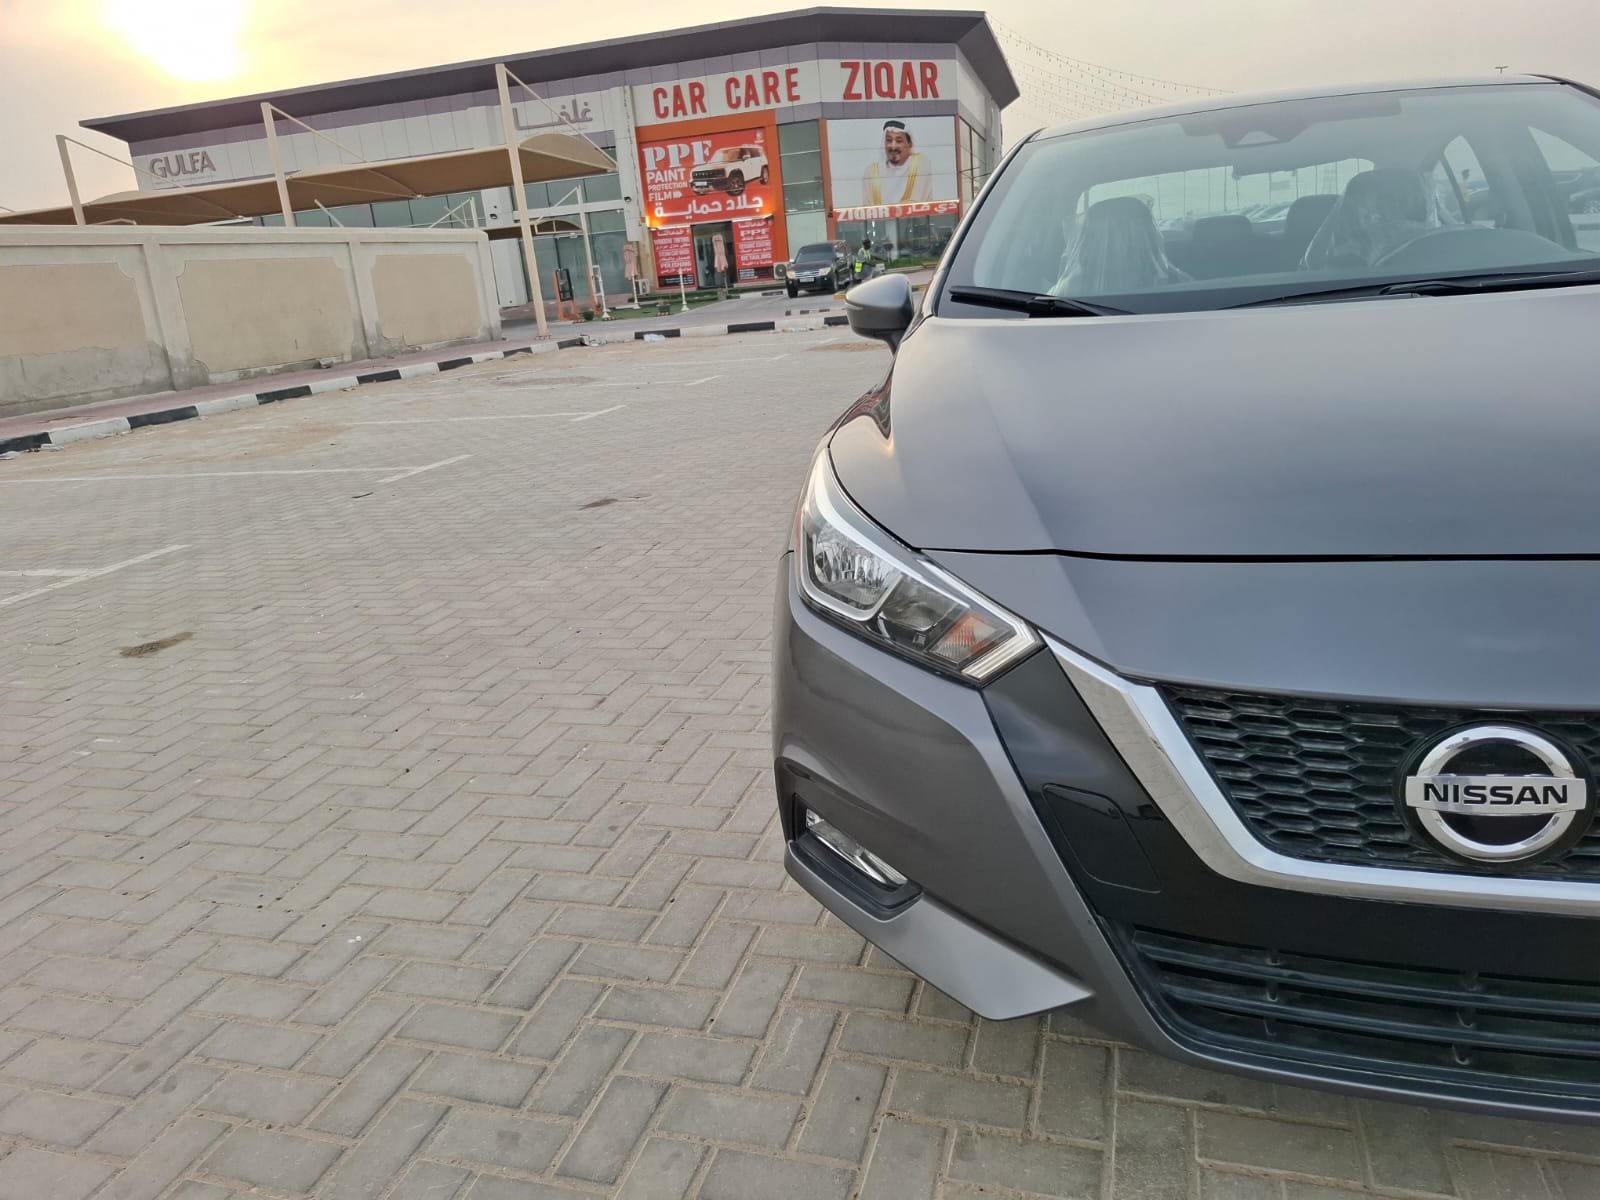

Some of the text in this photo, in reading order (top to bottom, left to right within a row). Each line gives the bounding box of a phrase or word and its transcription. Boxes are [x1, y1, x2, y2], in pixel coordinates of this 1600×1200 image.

[652, 67, 801, 119] CAR CARE
[840, 61, 940, 100] ZIQAR
[149, 150, 217, 178] GULFA
[642, 140, 712, 170] PPF
[646, 168, 686, 184] PAINT
[648, 181, 689, 191] PROTECTION
[649, 191, 673, 202] FILM
[1423, 782, 1568, 805] NISSAN
